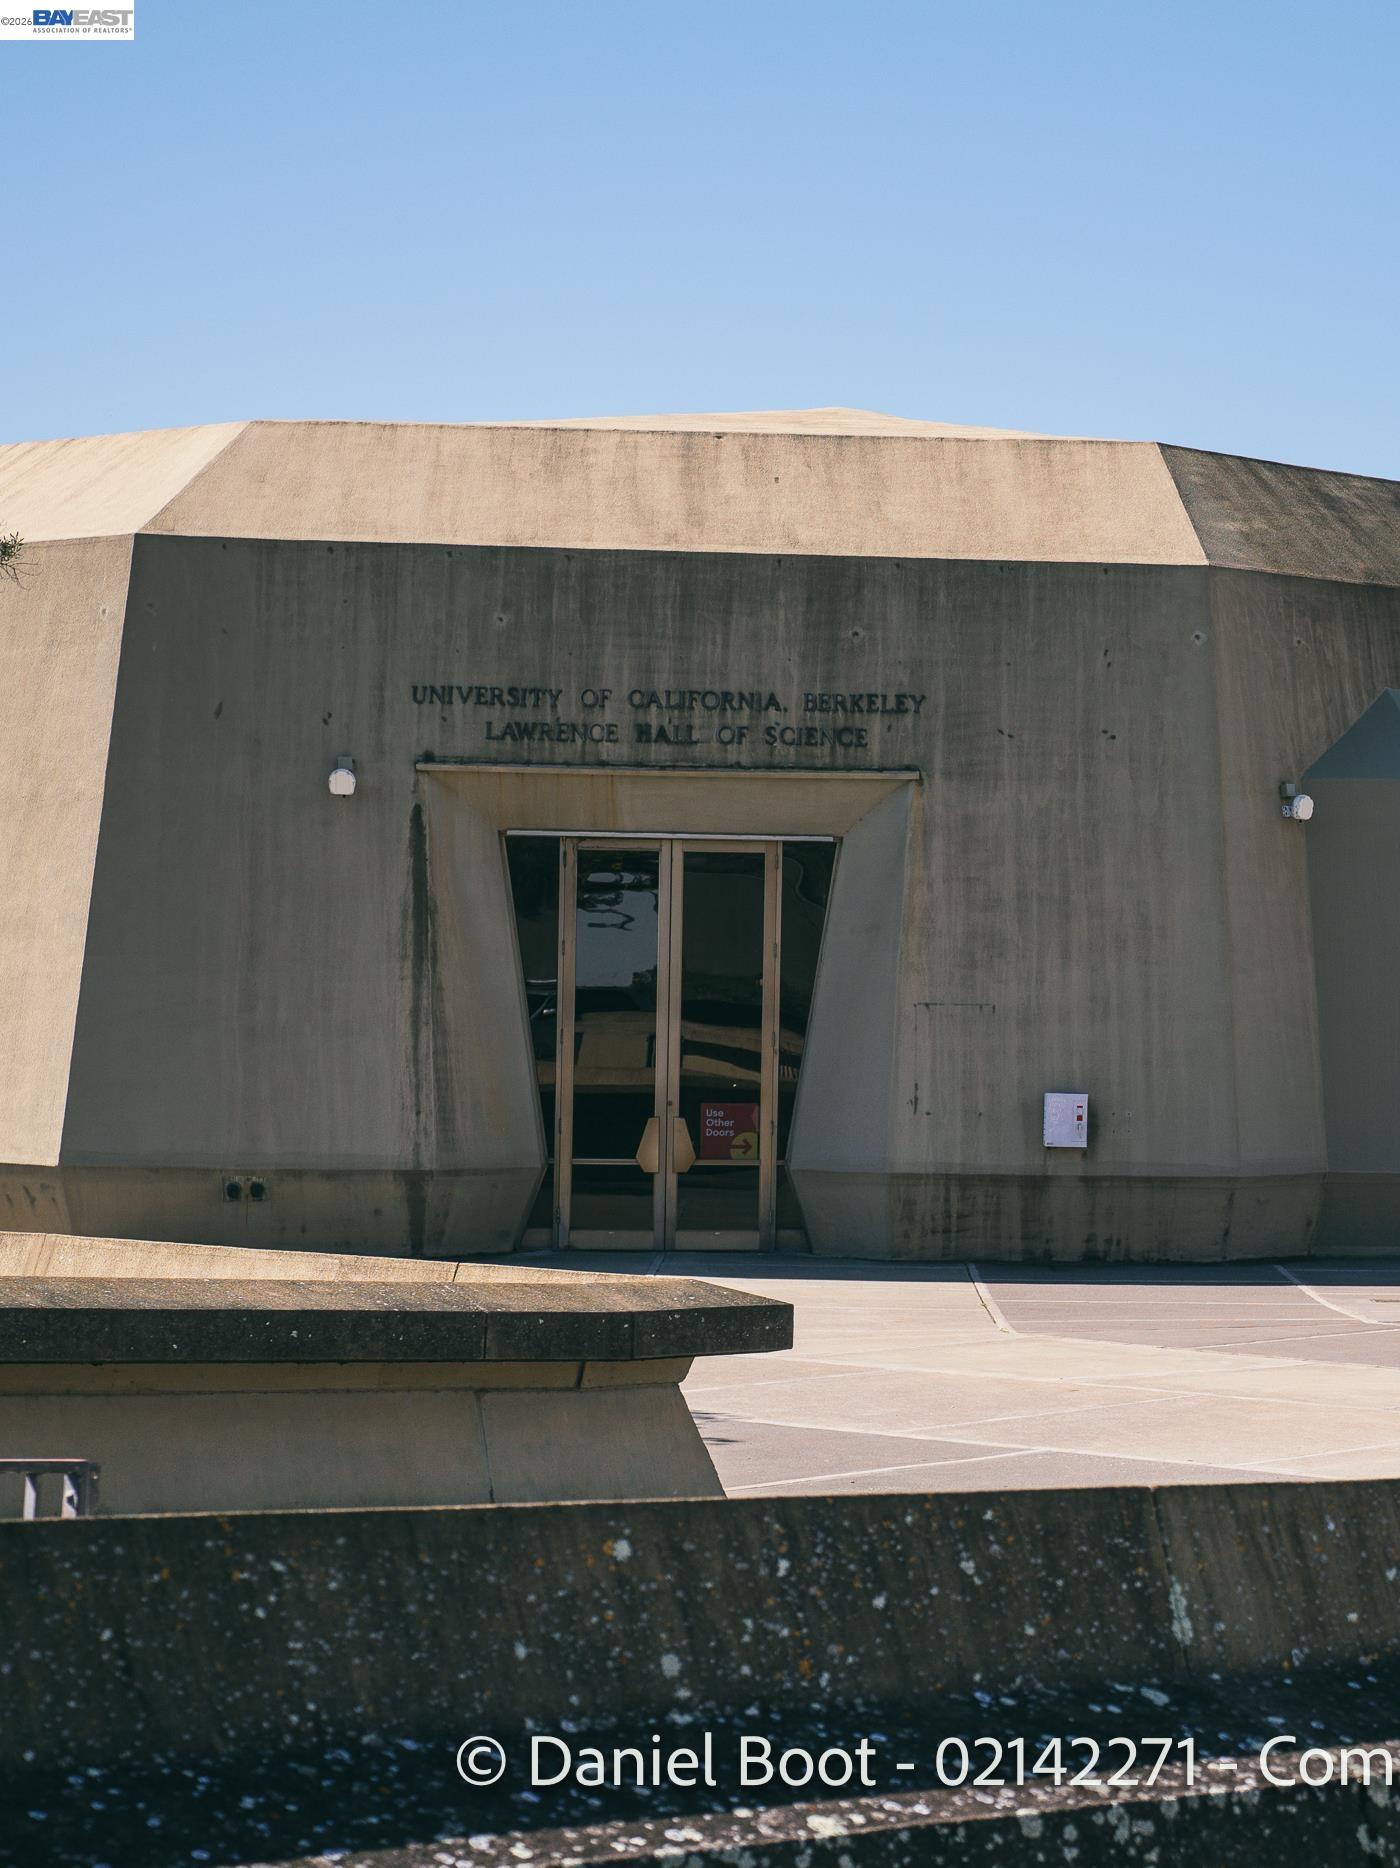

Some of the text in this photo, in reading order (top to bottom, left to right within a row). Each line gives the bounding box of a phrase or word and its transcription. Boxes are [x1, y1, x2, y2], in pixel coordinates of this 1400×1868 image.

[411, 685, 562, 708] UNIVERSITY
[581, 688, 613, 709] OF
[803, 692, 926, 715] BERKELEY
[485, 721, 868, 748] LAWRENCE HALL OF SCIENCE
[706, 1108, 724, 1117] Use
[706, 1118, 735, 1127] Other
[706, 1128, 735, 1136] Doors
